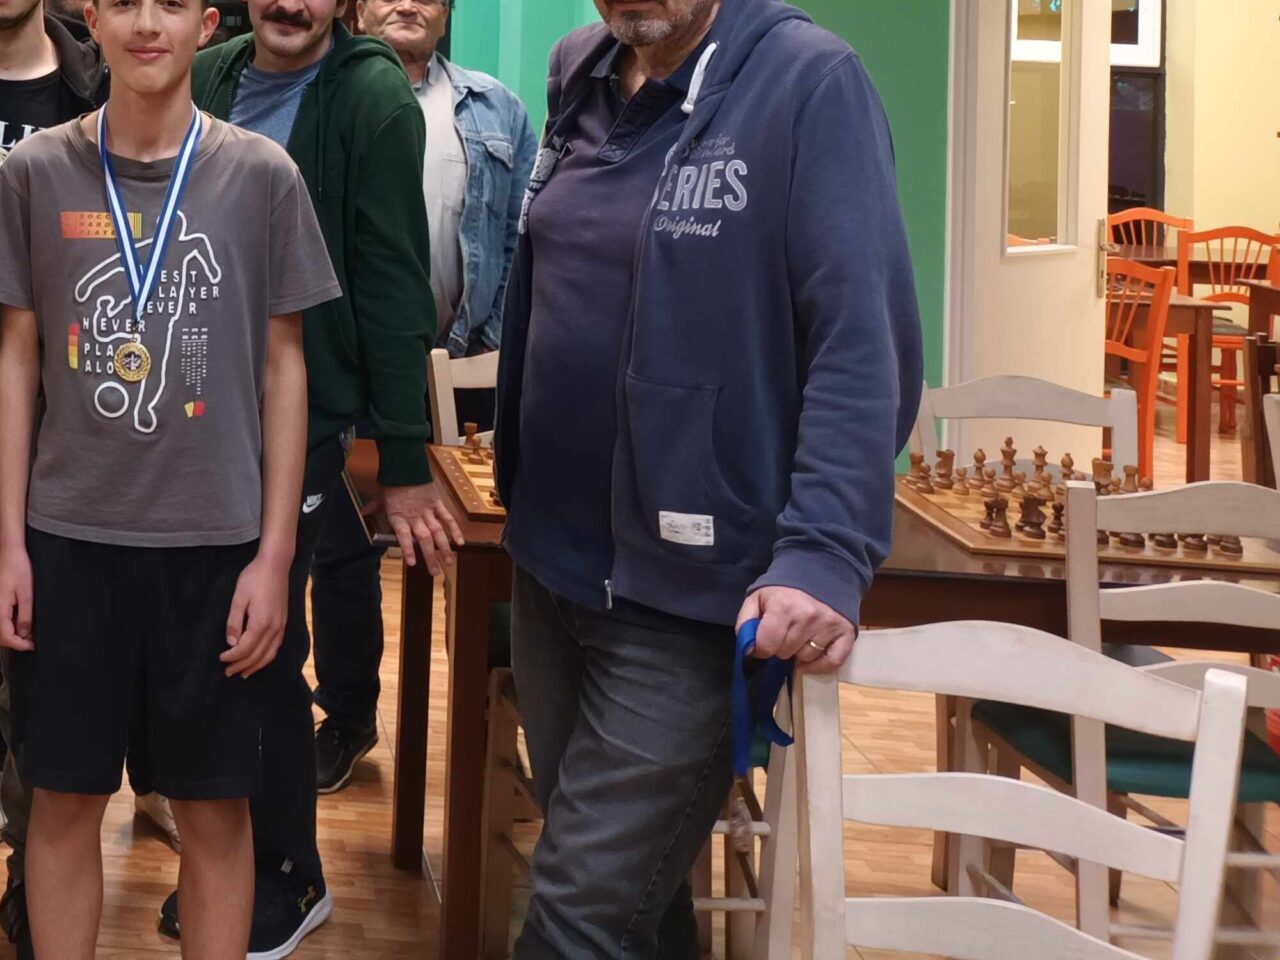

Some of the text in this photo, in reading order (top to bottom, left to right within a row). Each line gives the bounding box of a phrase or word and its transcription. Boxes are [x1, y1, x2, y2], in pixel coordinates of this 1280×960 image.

[655, 159, 748, 211] ERIES
[160, 270, 197, 283] EST
[158, 286, 220, 299] LAYER
[82, 317, 146, 332] NEVER
[83, 343, 115, 357] PLA
[85, 360, 115, 375] ALO
